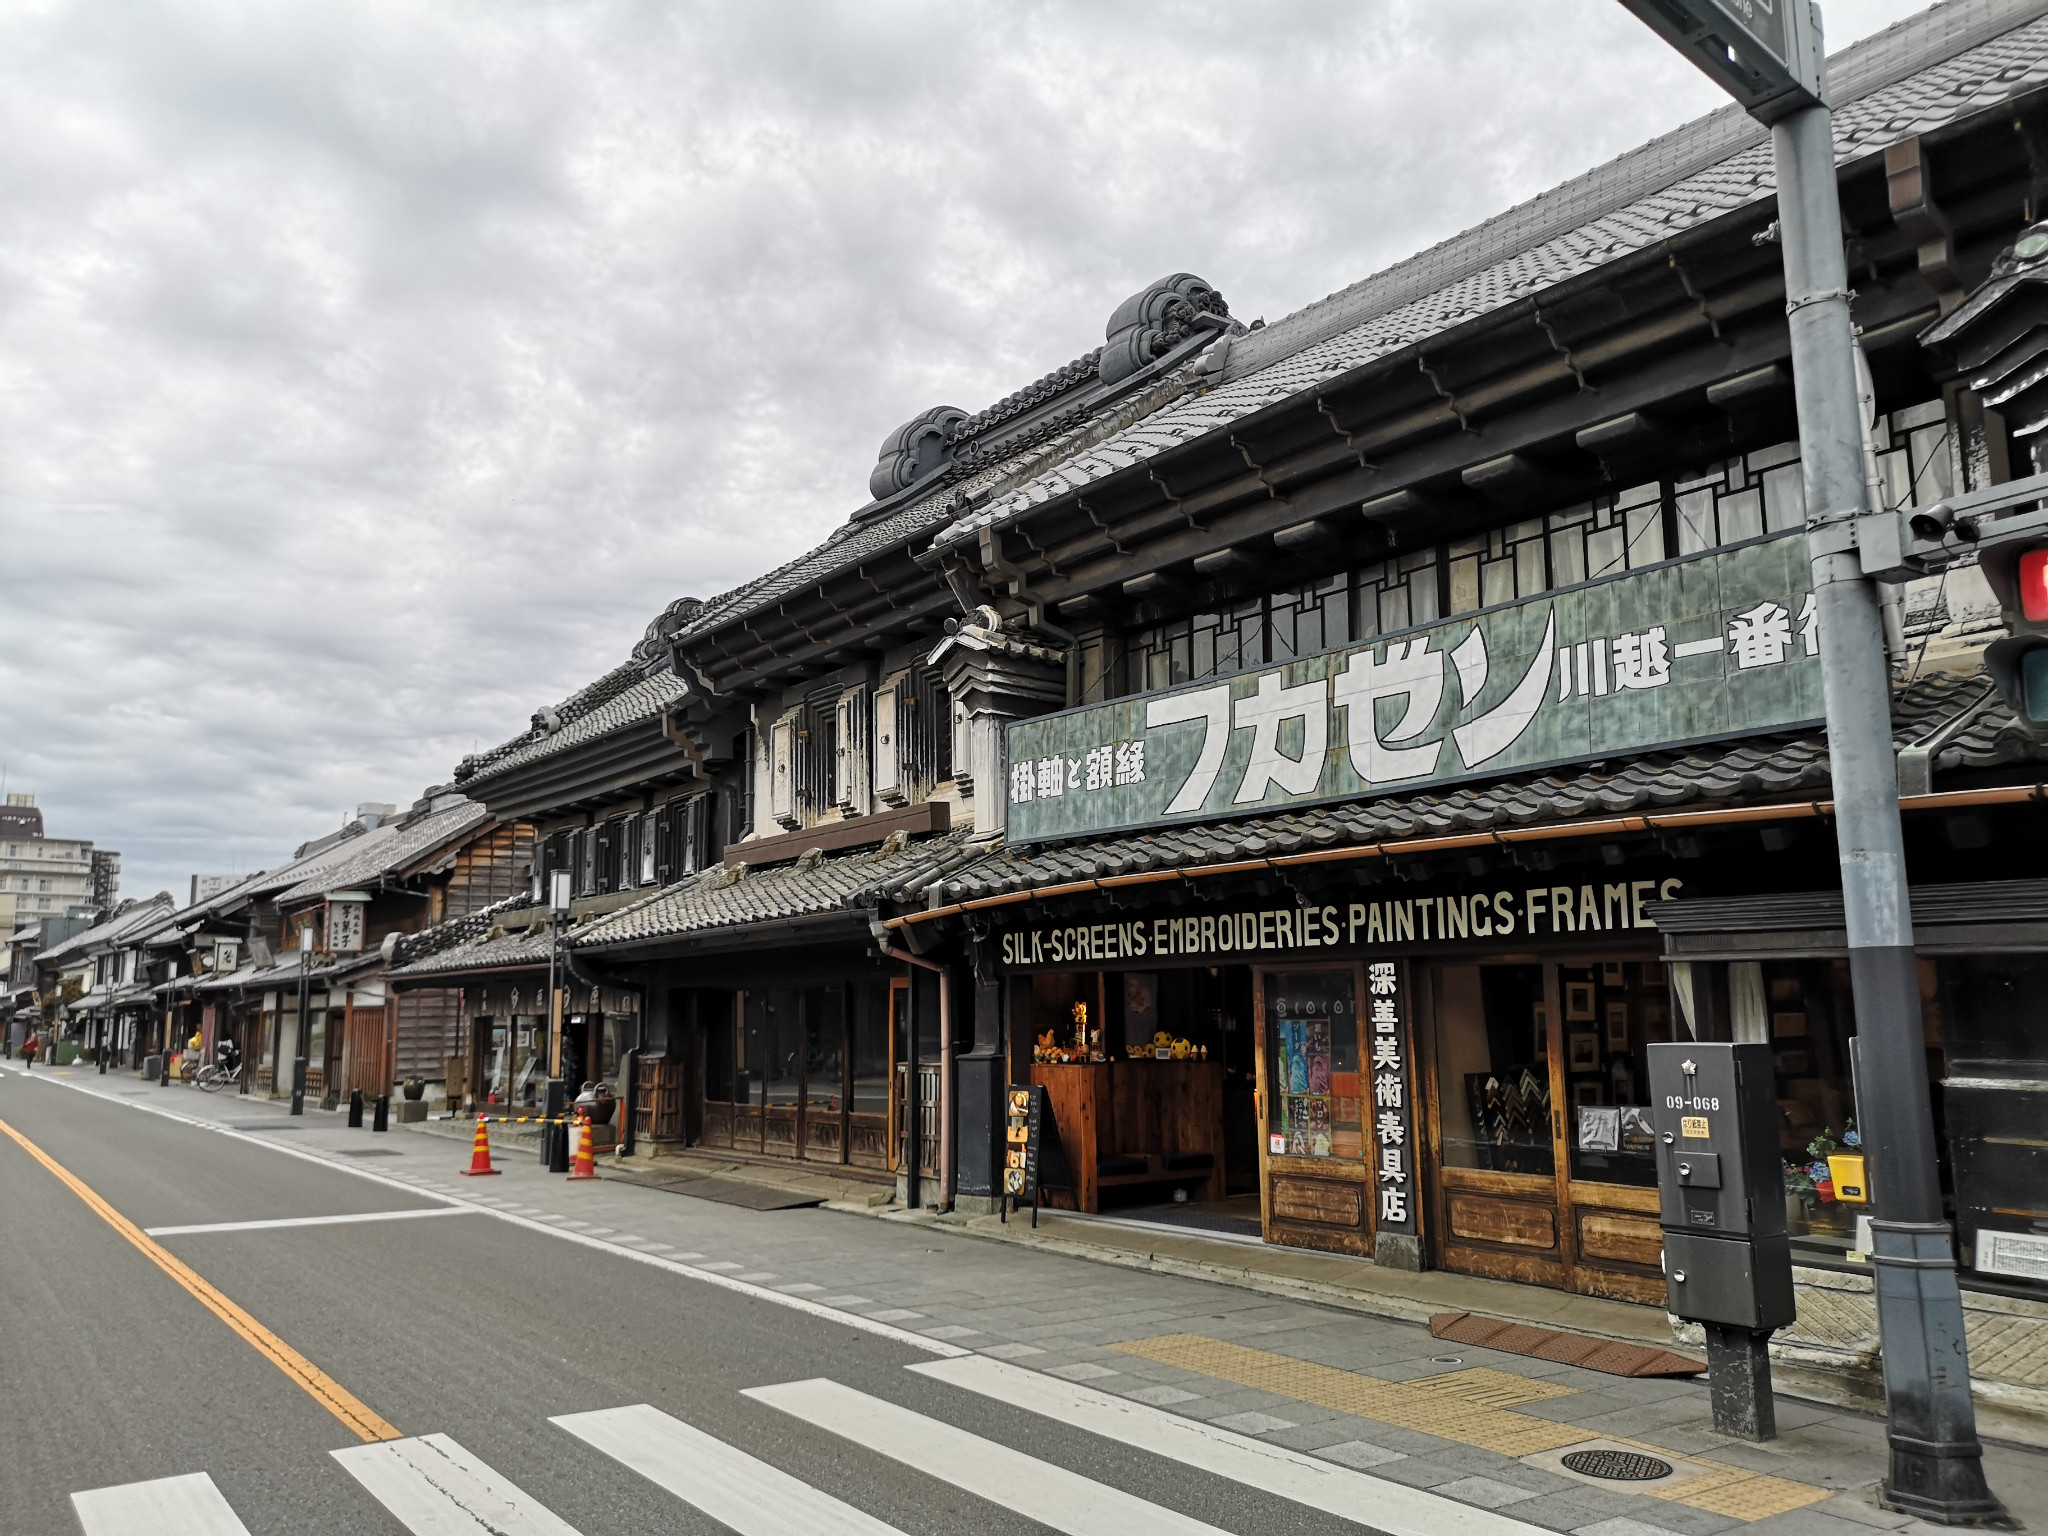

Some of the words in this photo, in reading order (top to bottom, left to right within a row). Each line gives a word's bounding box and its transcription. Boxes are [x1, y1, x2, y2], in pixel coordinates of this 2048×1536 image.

[1011, 740, 1147, 804] 掛軸と額縁
[1368, 962, 1407, 1222] 深善美術表具店
[1666, 1096, 1720, 1111] 09-068
